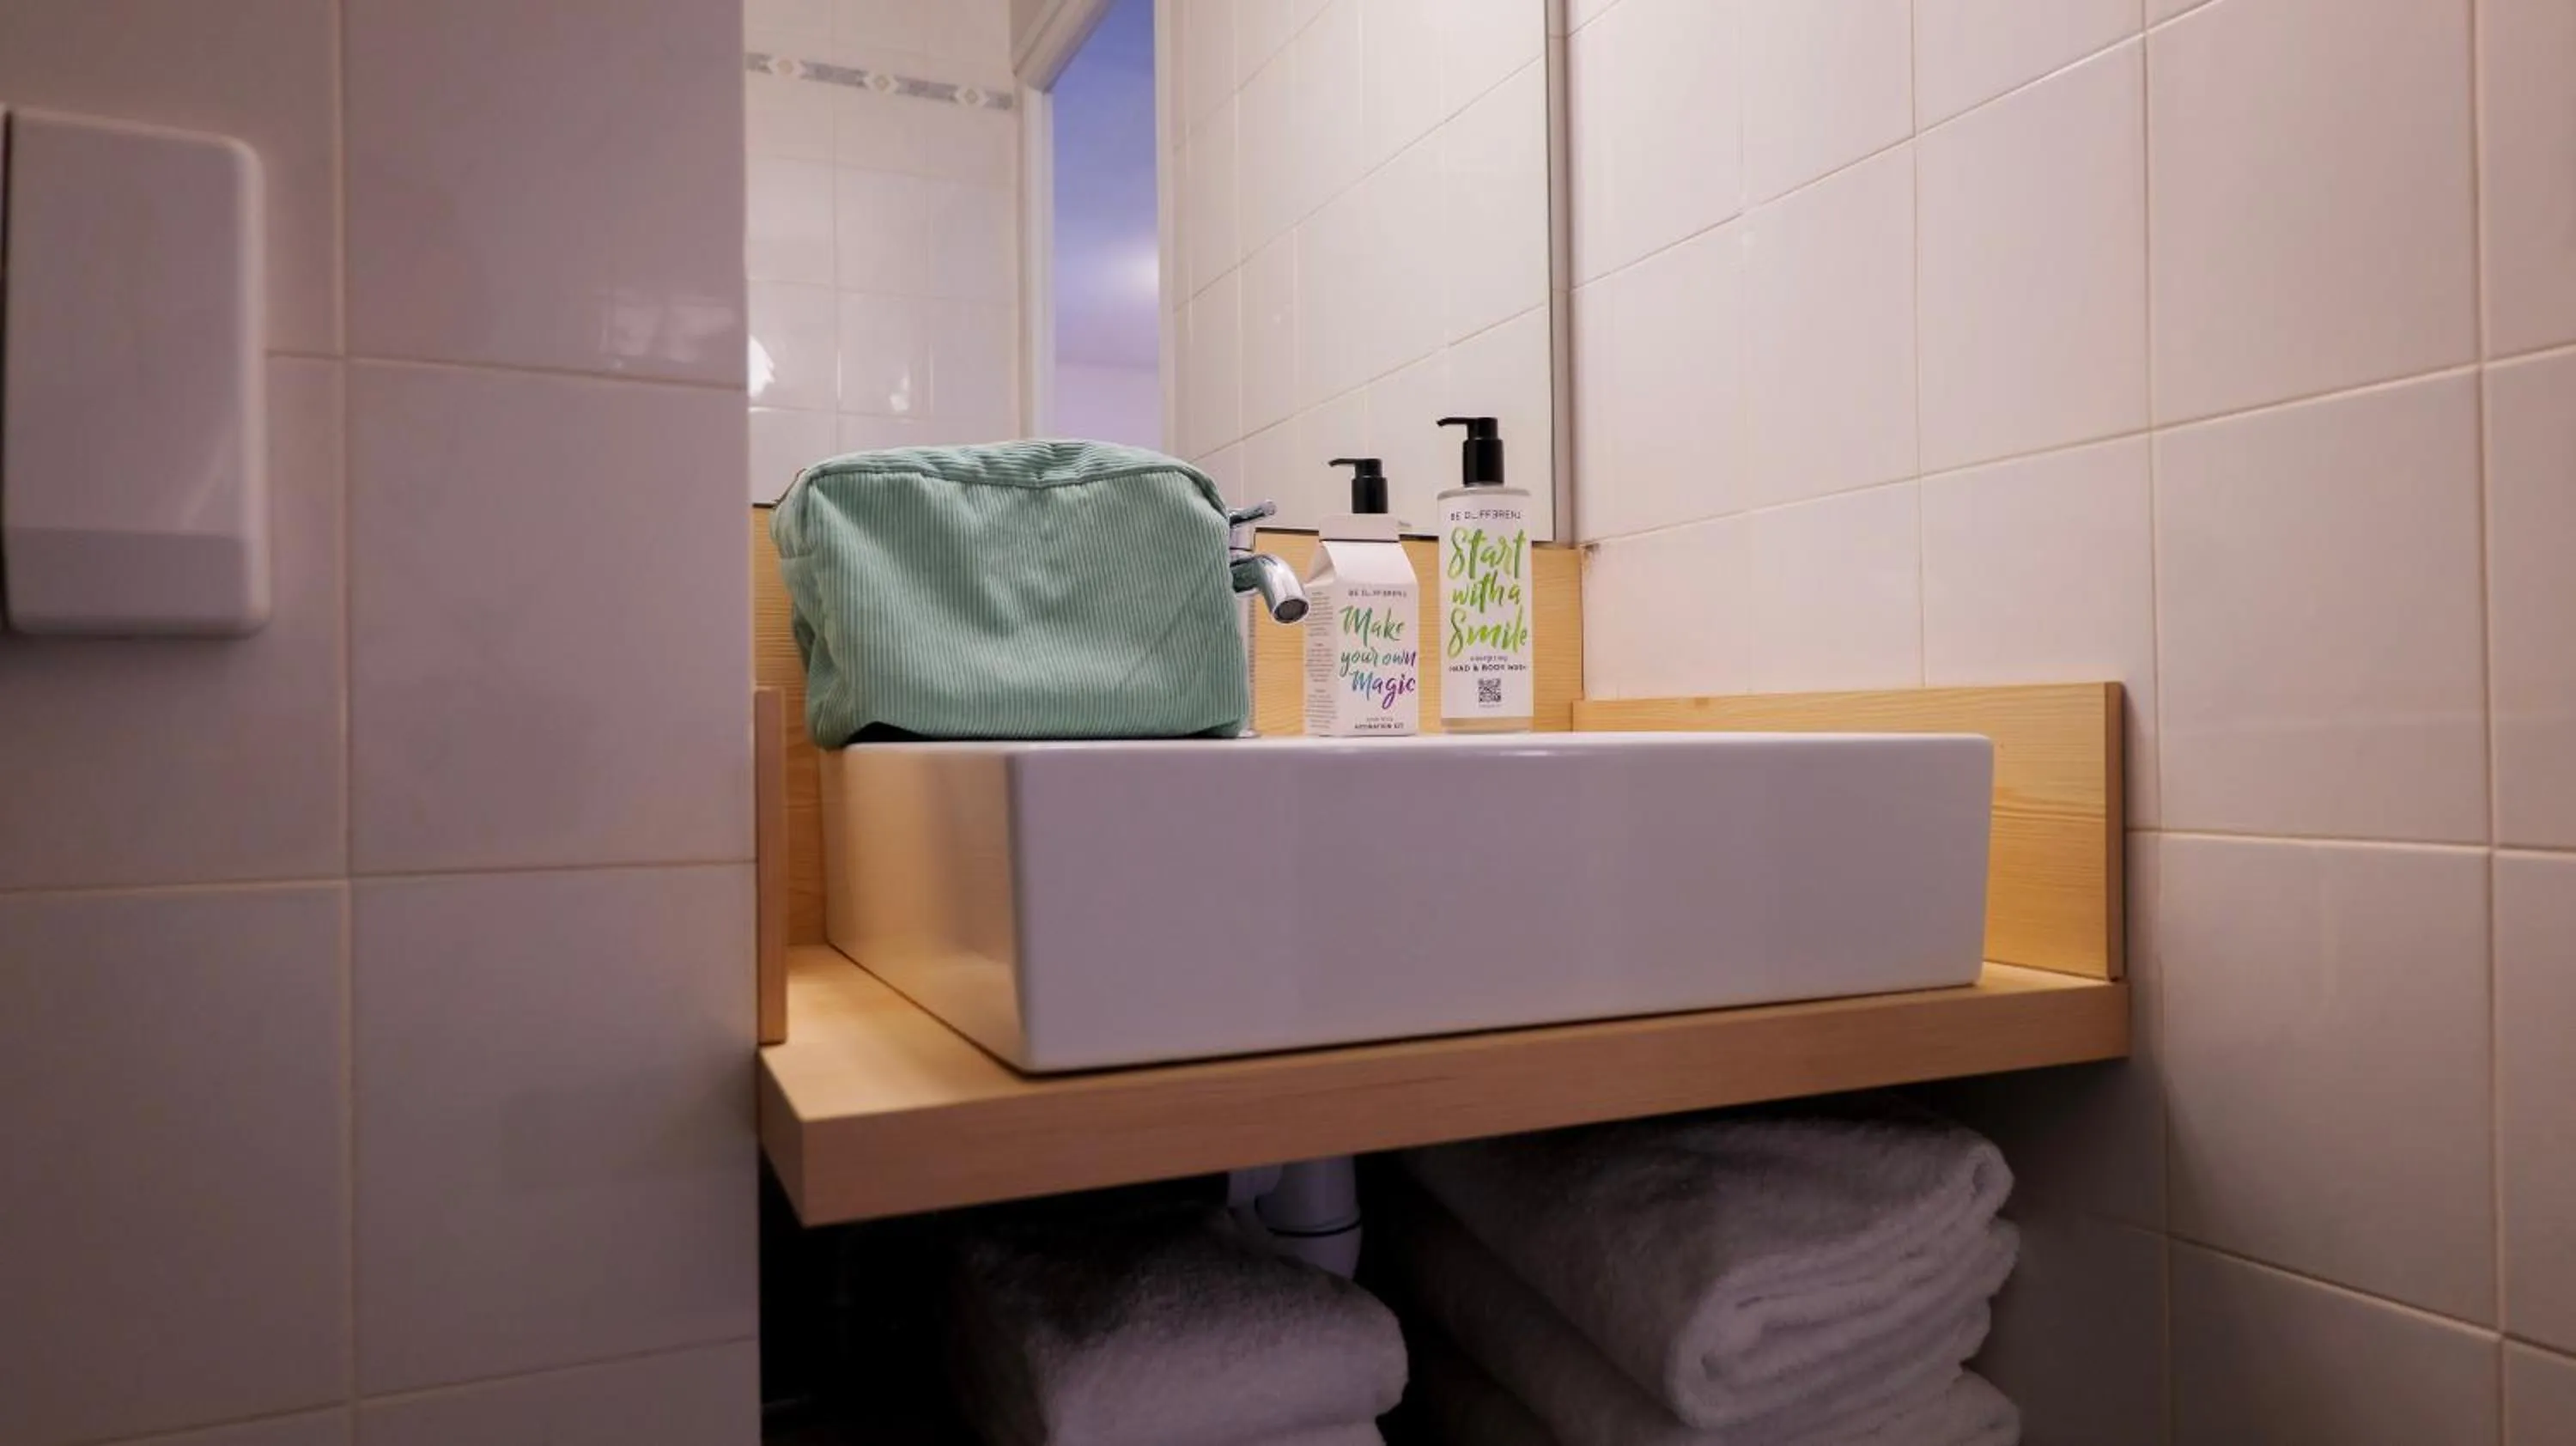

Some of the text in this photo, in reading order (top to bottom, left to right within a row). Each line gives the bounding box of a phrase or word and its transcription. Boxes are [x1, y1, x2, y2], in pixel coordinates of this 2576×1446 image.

[1448, 526, 1527, 580] Start
[1450, 569, 1522, 614] with a
[1340, 605, 1406, 648] Make
[1448, 605, 1528, 659] Smile
[1339, 647, 1379, 677] your
[1382, 649, 1417, 668] own
[1349, 670, 1417, 710] Magic
